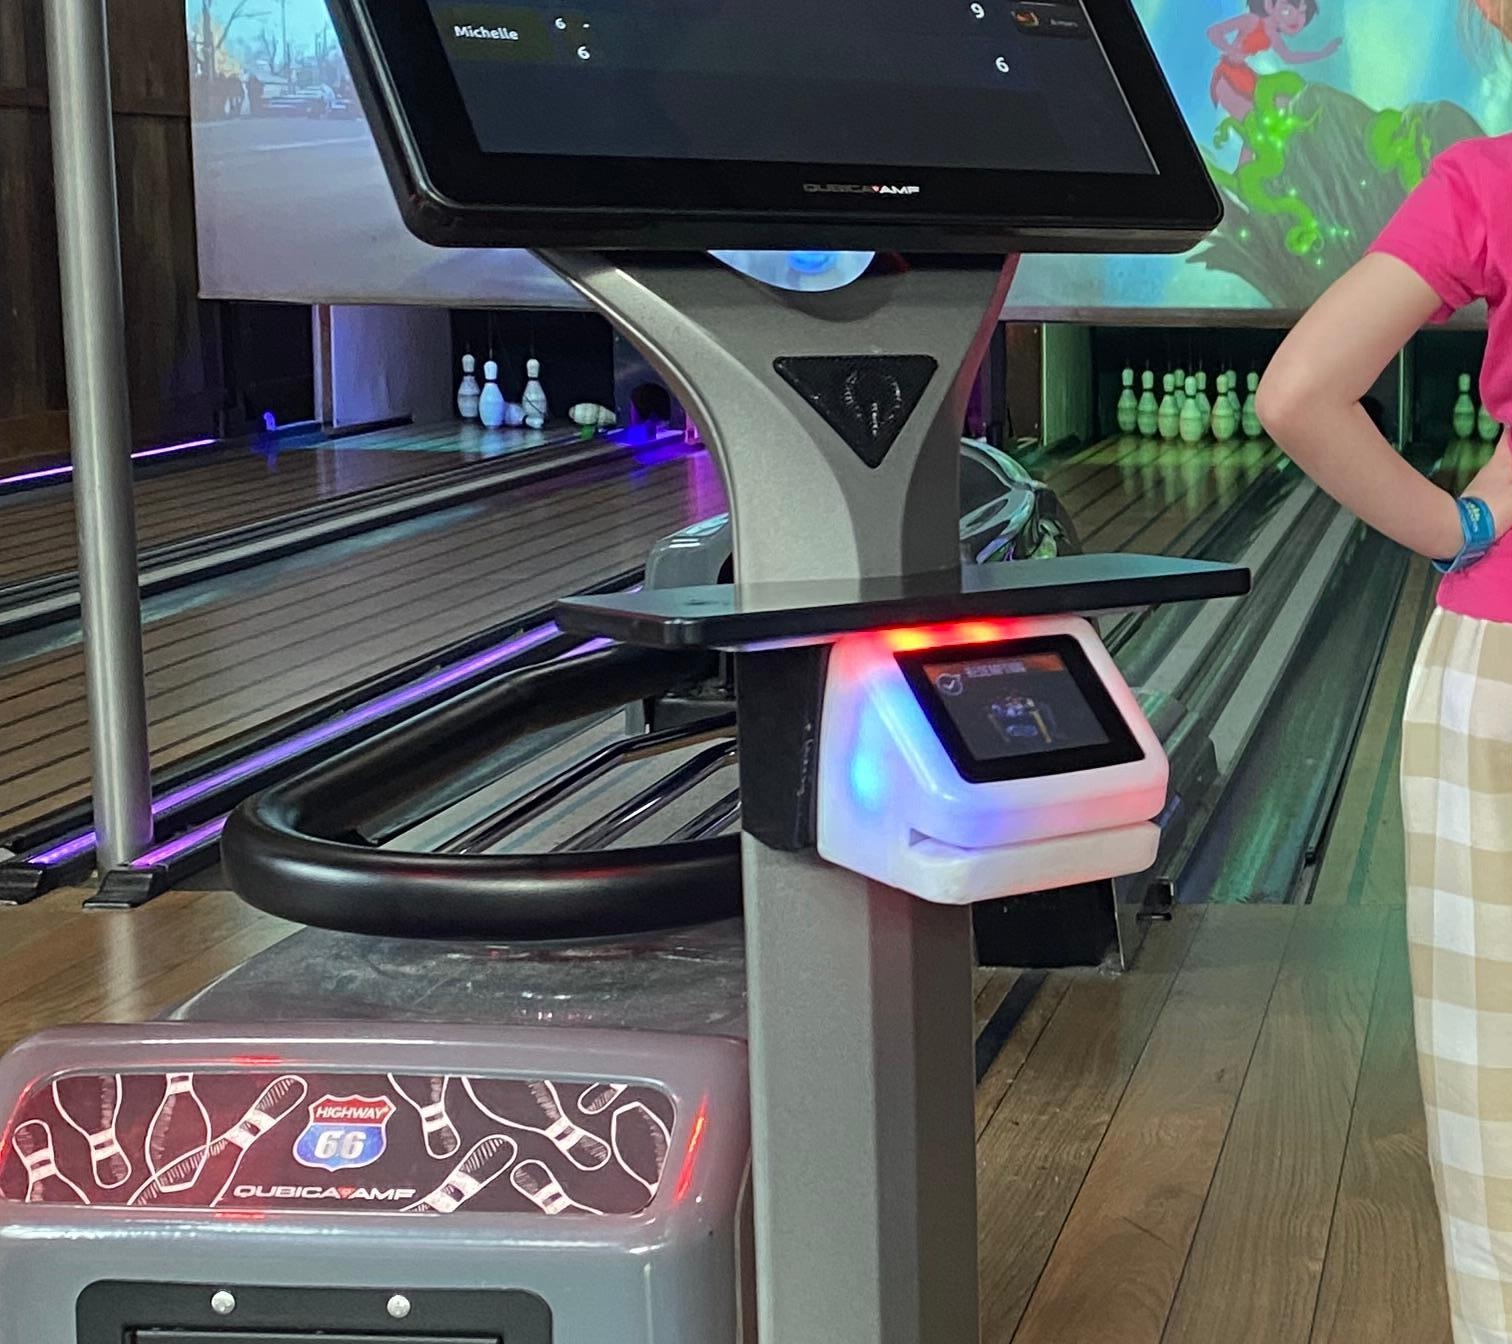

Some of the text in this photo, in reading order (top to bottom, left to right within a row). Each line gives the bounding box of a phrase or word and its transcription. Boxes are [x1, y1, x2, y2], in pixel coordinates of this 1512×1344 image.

[970, 3, 985, 19] 9
[555, 17, 566, 29] 6
[454, 25, 1009, 72] Michelle 6 6
[316, 1107, 383, 1119] HIGHWAY
[314, 1130, 367, 1159] 66
